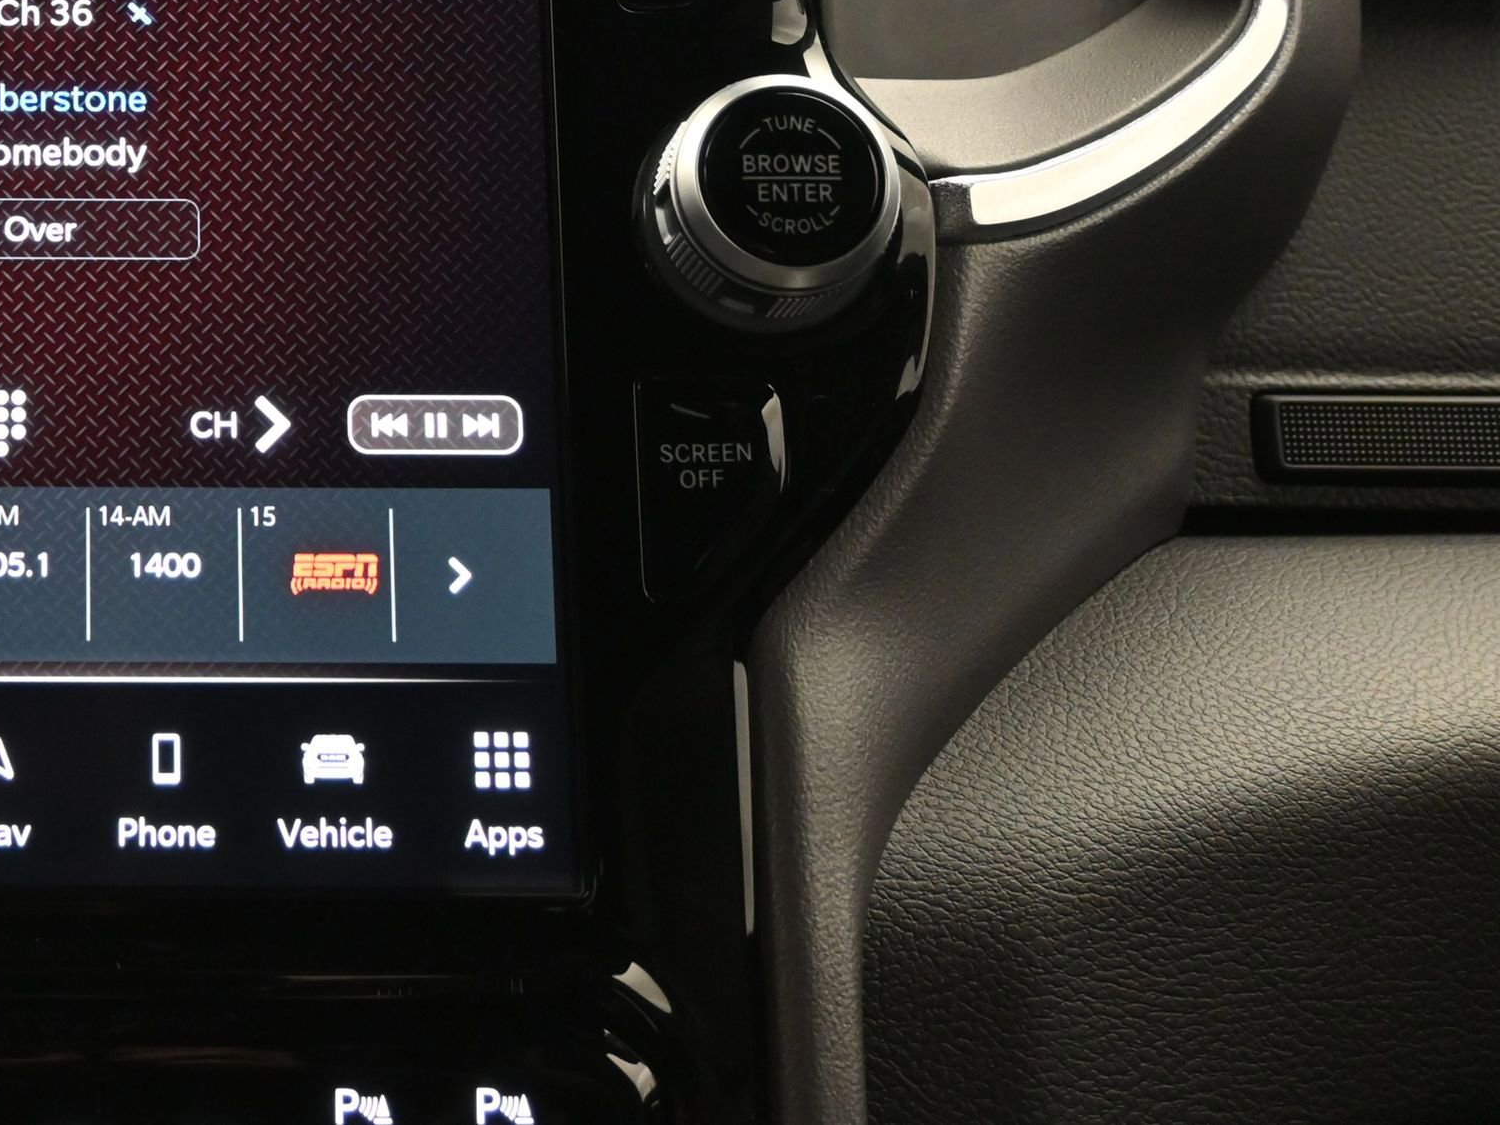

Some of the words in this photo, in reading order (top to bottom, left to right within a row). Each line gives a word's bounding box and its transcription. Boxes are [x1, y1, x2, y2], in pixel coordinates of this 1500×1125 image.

[762, 116, 816, 135] TUNE
[742, 154, 841, 174] BROWSE
[757, 183, 833, 204] ENTER
[4, 215, 77, 243] Over
[758, 212, 833, 235] SCROLL
[190, 410, 238, 439] CH
[660, 442, 752, 463] SCREEN
[679, 469, 724, 489] OFF
[98, 505, 171, 527] 14-AM
[250, 505, 276, 527] 15
[130, 552, 202, 579] 1400
[292, 553, 379, 577] ESPN
[302, 577, 366, 590] RADIO
[117, 815, 217, 849] Phone
[276, 816, 394, 850] Vehicle
[464, 818, 545, 857] Apps
